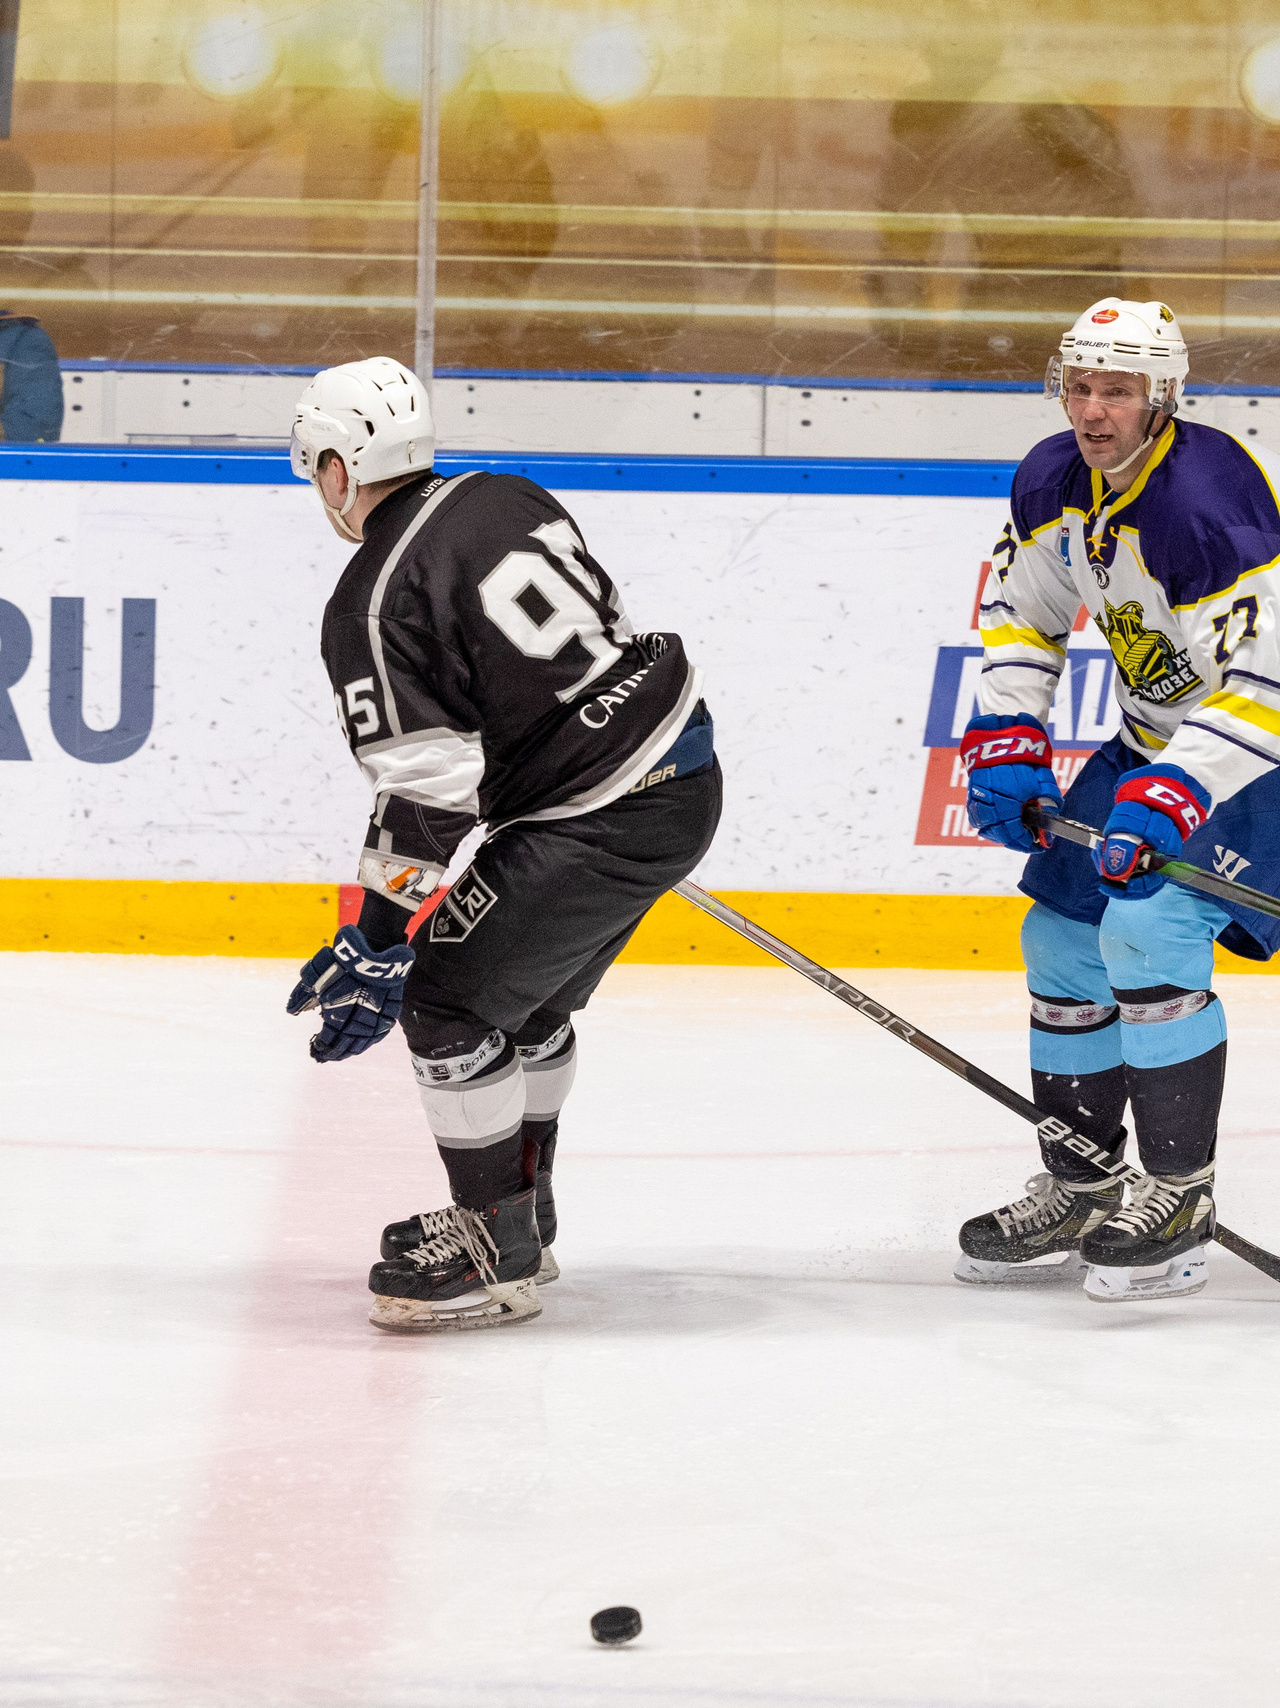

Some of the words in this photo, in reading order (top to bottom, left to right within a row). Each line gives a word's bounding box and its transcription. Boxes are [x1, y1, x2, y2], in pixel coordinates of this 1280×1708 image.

[1075, 340, 1111, 349] BAUER
[1211, 594, 1259, 666] 77
[961, 736, 1047, 772] CCM
[1144, 780, 1201, 837] CC
[334, 937, 416, 979] CCM
